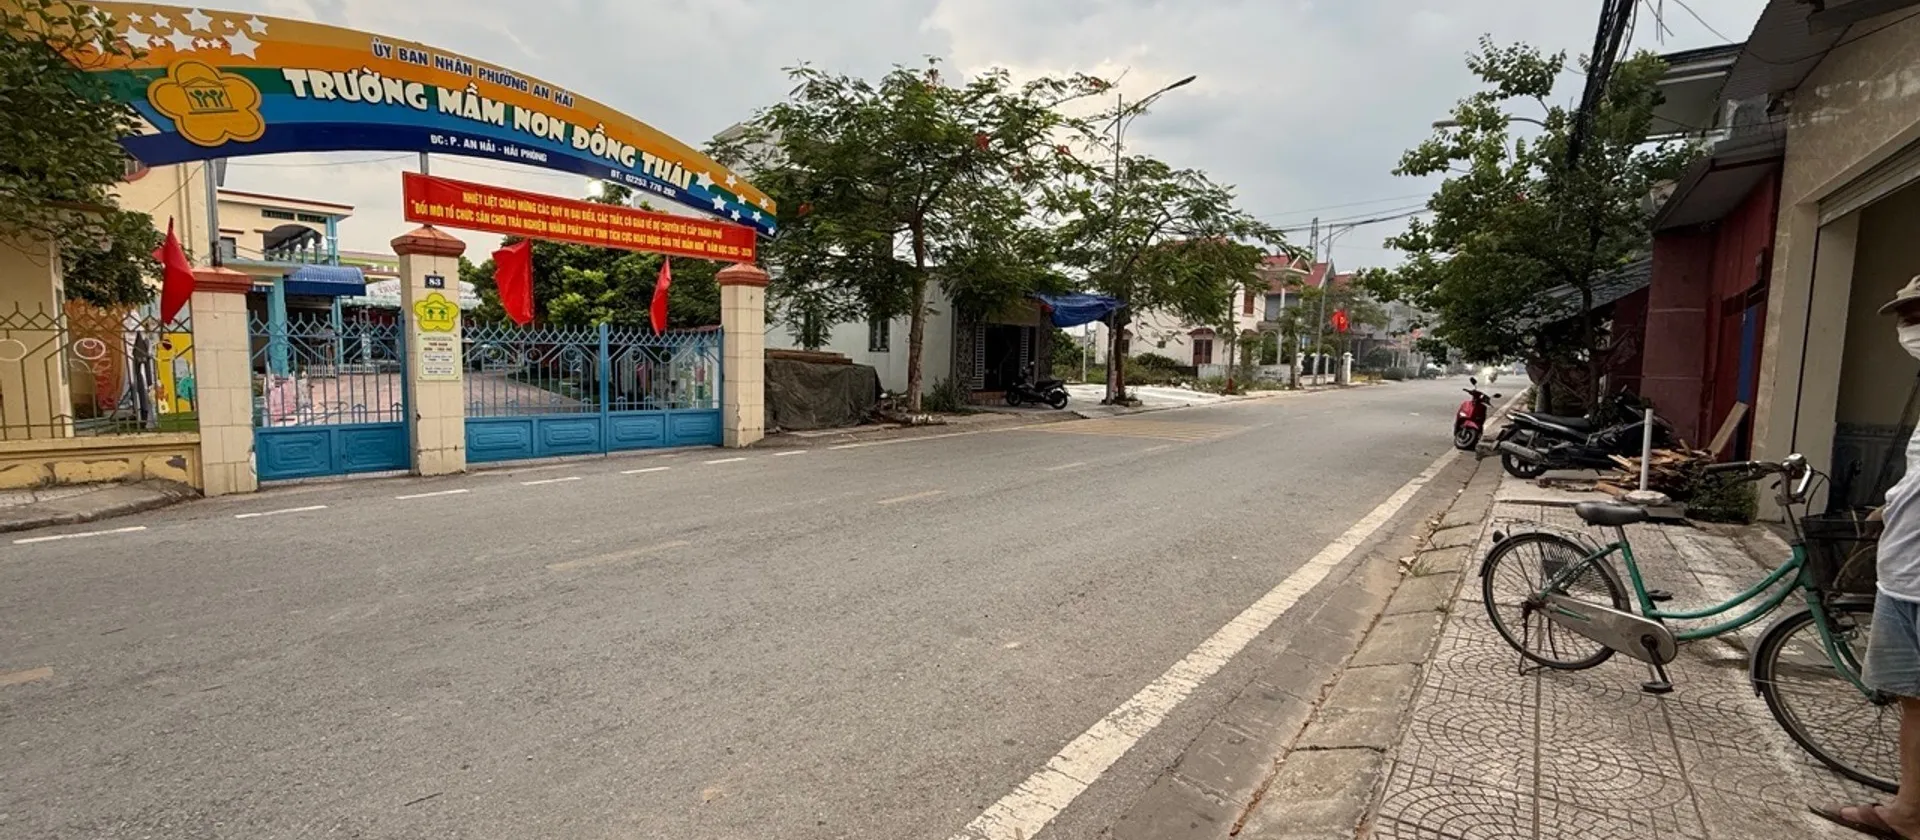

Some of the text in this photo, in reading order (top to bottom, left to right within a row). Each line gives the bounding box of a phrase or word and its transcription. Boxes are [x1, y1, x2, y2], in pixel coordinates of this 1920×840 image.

[372, 38, 574, 108] ỦY BAN NHÂN PHƯỜNG AN HẢI
[282, 66, 692, 190] TRƯỜNG MẦM NON ĐỒNG THÁI
[430, 134, 448, 145] ĐC:
[450, 136, 461, 147] P.
[463, 139, 477, 149] AN
[479, 139, 496, 152] HẢI
[503, 144, 518, 157] HẢI
[520, 149, 548, 162] PHÒNG
[429, 203, 444, 217] MỚI
[445, 203, 454, 219] TỔ
[456, 207, 474, 221] CHỨC
[476, 209, 490, 224] SÂN
[491, 212, 507, 226] CHƠI
[507, 214, 522, 228] TRẢI
[523, 218, 547, 233] NGHIỆM
[462, 192, 483, 207] NHIỆT
[484, 194, 498, 209] LIỆT
[499, 196, 517, 211] CHÀO
[518, 199, 536, 213] MỪNG
[537, 202, 550, 215] CÁC
[597, 211, 608, 224] CÁC
[428, 278, 441, 286] 83
